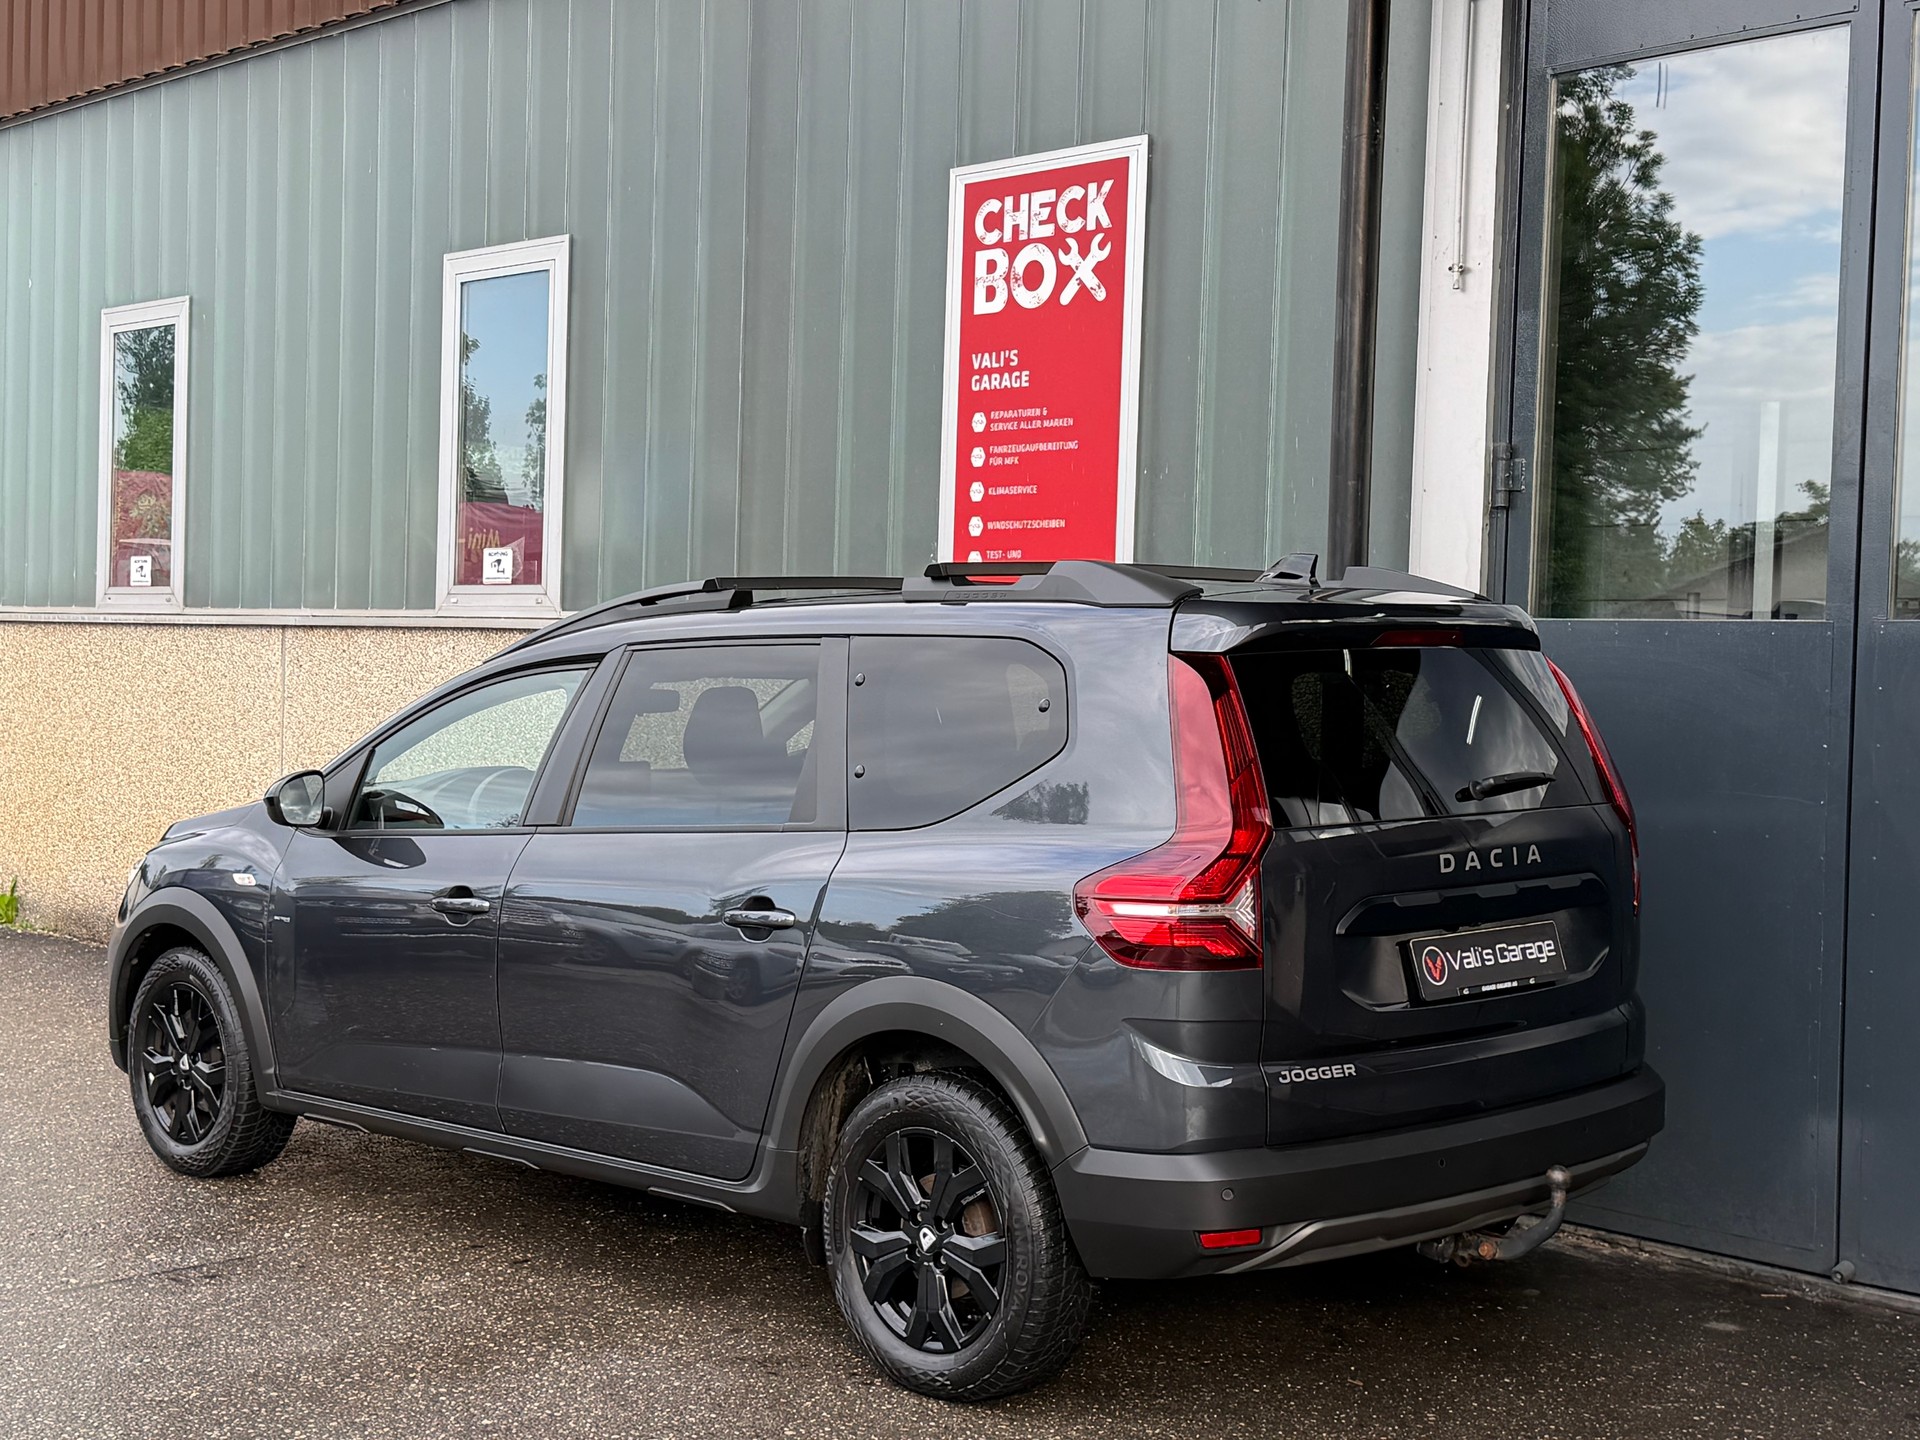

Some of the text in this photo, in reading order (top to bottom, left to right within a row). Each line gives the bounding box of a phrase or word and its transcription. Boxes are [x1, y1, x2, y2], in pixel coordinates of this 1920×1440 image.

[974, 179, 1114, 245] CHECK
[973, 232, 1112, 316] BOX
[971, 349, 1019, 370] VALI'S
[971, 370, 1030, 392] GARAGE
[990, 408, 1041, 419] REPARATUREN
[990, 418, 1074, 432] SERVICE ALLER MARKEN
[989, 440, 1079, 454] FAHRZEUGAUFBEREITUNG
[989, 456, 1019, 466] FÜR MFK
[988, 484, 1038, 496] KLIMASERVICE
[987, 519, 1066, 530] WINDSCHUTZSCHEIBEN
[1007, 550, 1022, 559] UND
[1439, 844, 1542, 874] DACIA
[1446, 946, 1495, 971] Vali's
[1495, 939, 1557, 964] Garage
[1278, 1063, 1357, 1084] JOGGER
[823, 1164, 839, 1265] UNIROYAL
